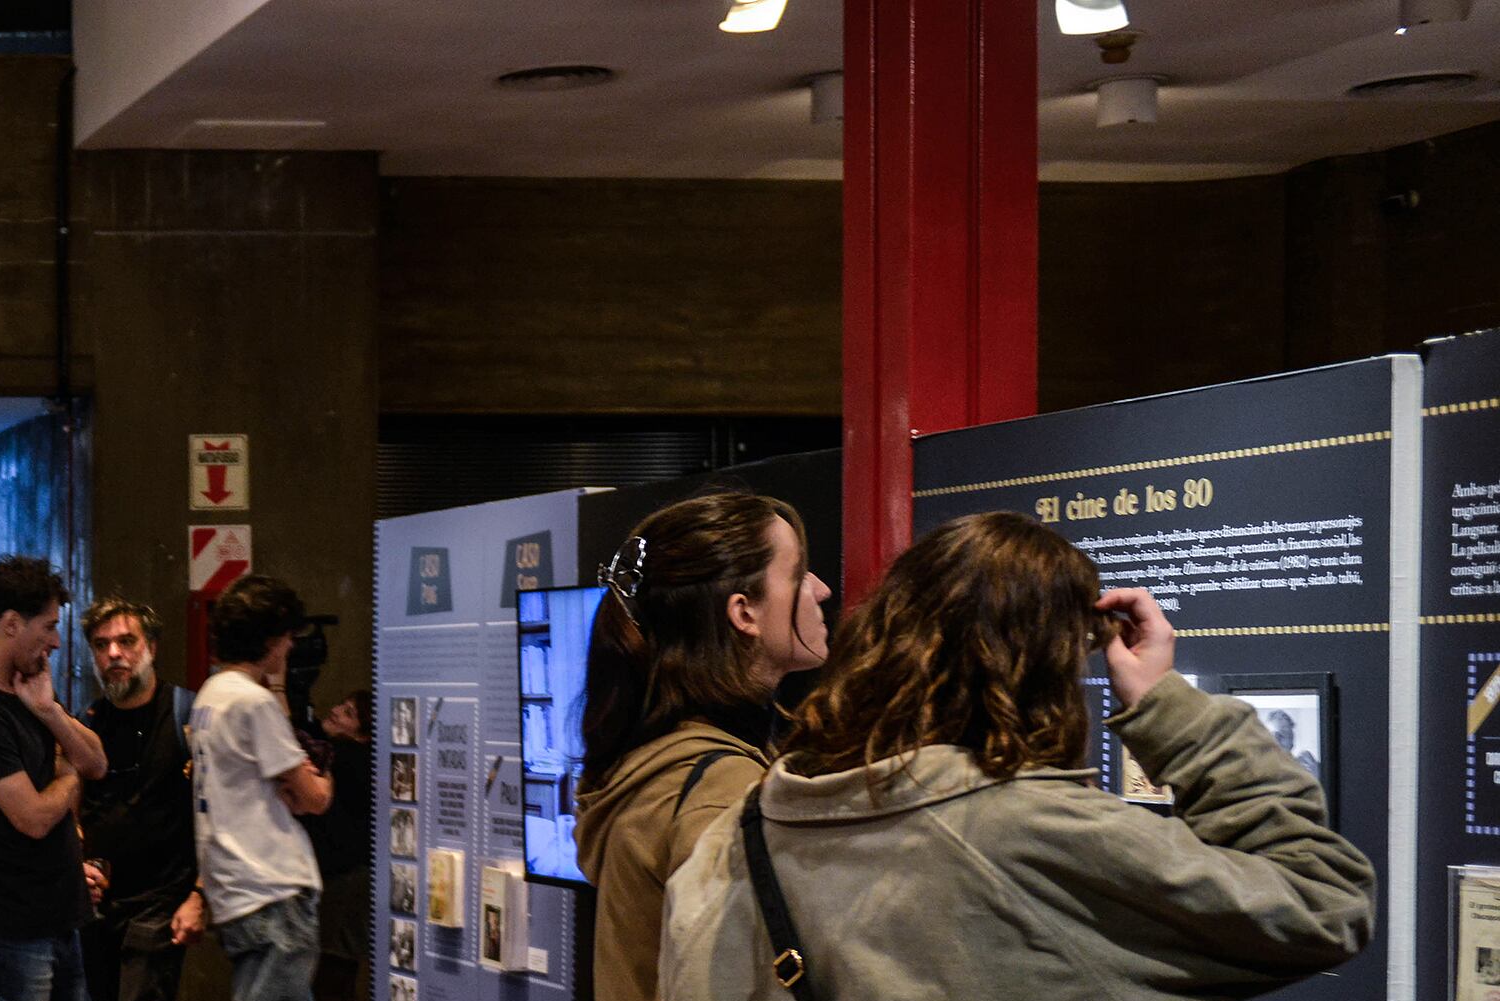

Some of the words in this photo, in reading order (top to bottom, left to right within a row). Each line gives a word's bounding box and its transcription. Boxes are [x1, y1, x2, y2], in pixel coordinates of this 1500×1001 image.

[1035, 496, 1059, 523] El
[1065, 491, 1107, 521] cine
[1113, 487, 1139, 516] de
[1145, 483, 1177, 513] los
[1183, 477, 1214, 509] 80
[1452, 482, 1487, 498] Ambas
[515, 542, 540, 569] CASO
